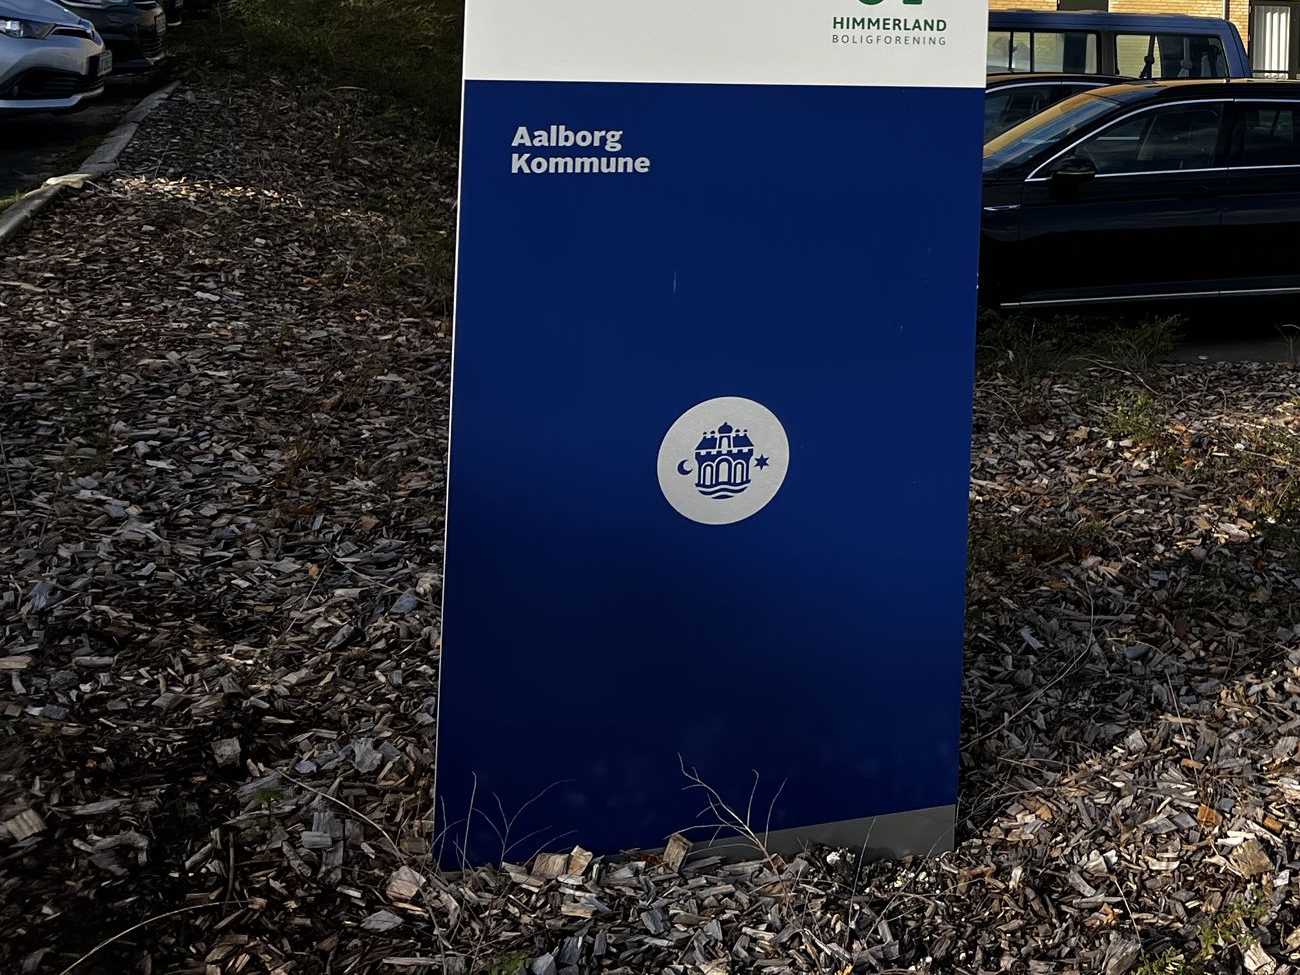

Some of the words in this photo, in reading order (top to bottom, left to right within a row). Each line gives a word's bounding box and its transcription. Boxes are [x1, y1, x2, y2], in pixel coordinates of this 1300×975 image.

[832, 16, 947, 32] HIMMERLAND
[832, 34, 947, 46] BOLIGFORENING
[511, 125, 623, 152] Aalborg
[511, 153, 651, 174] Kommune
